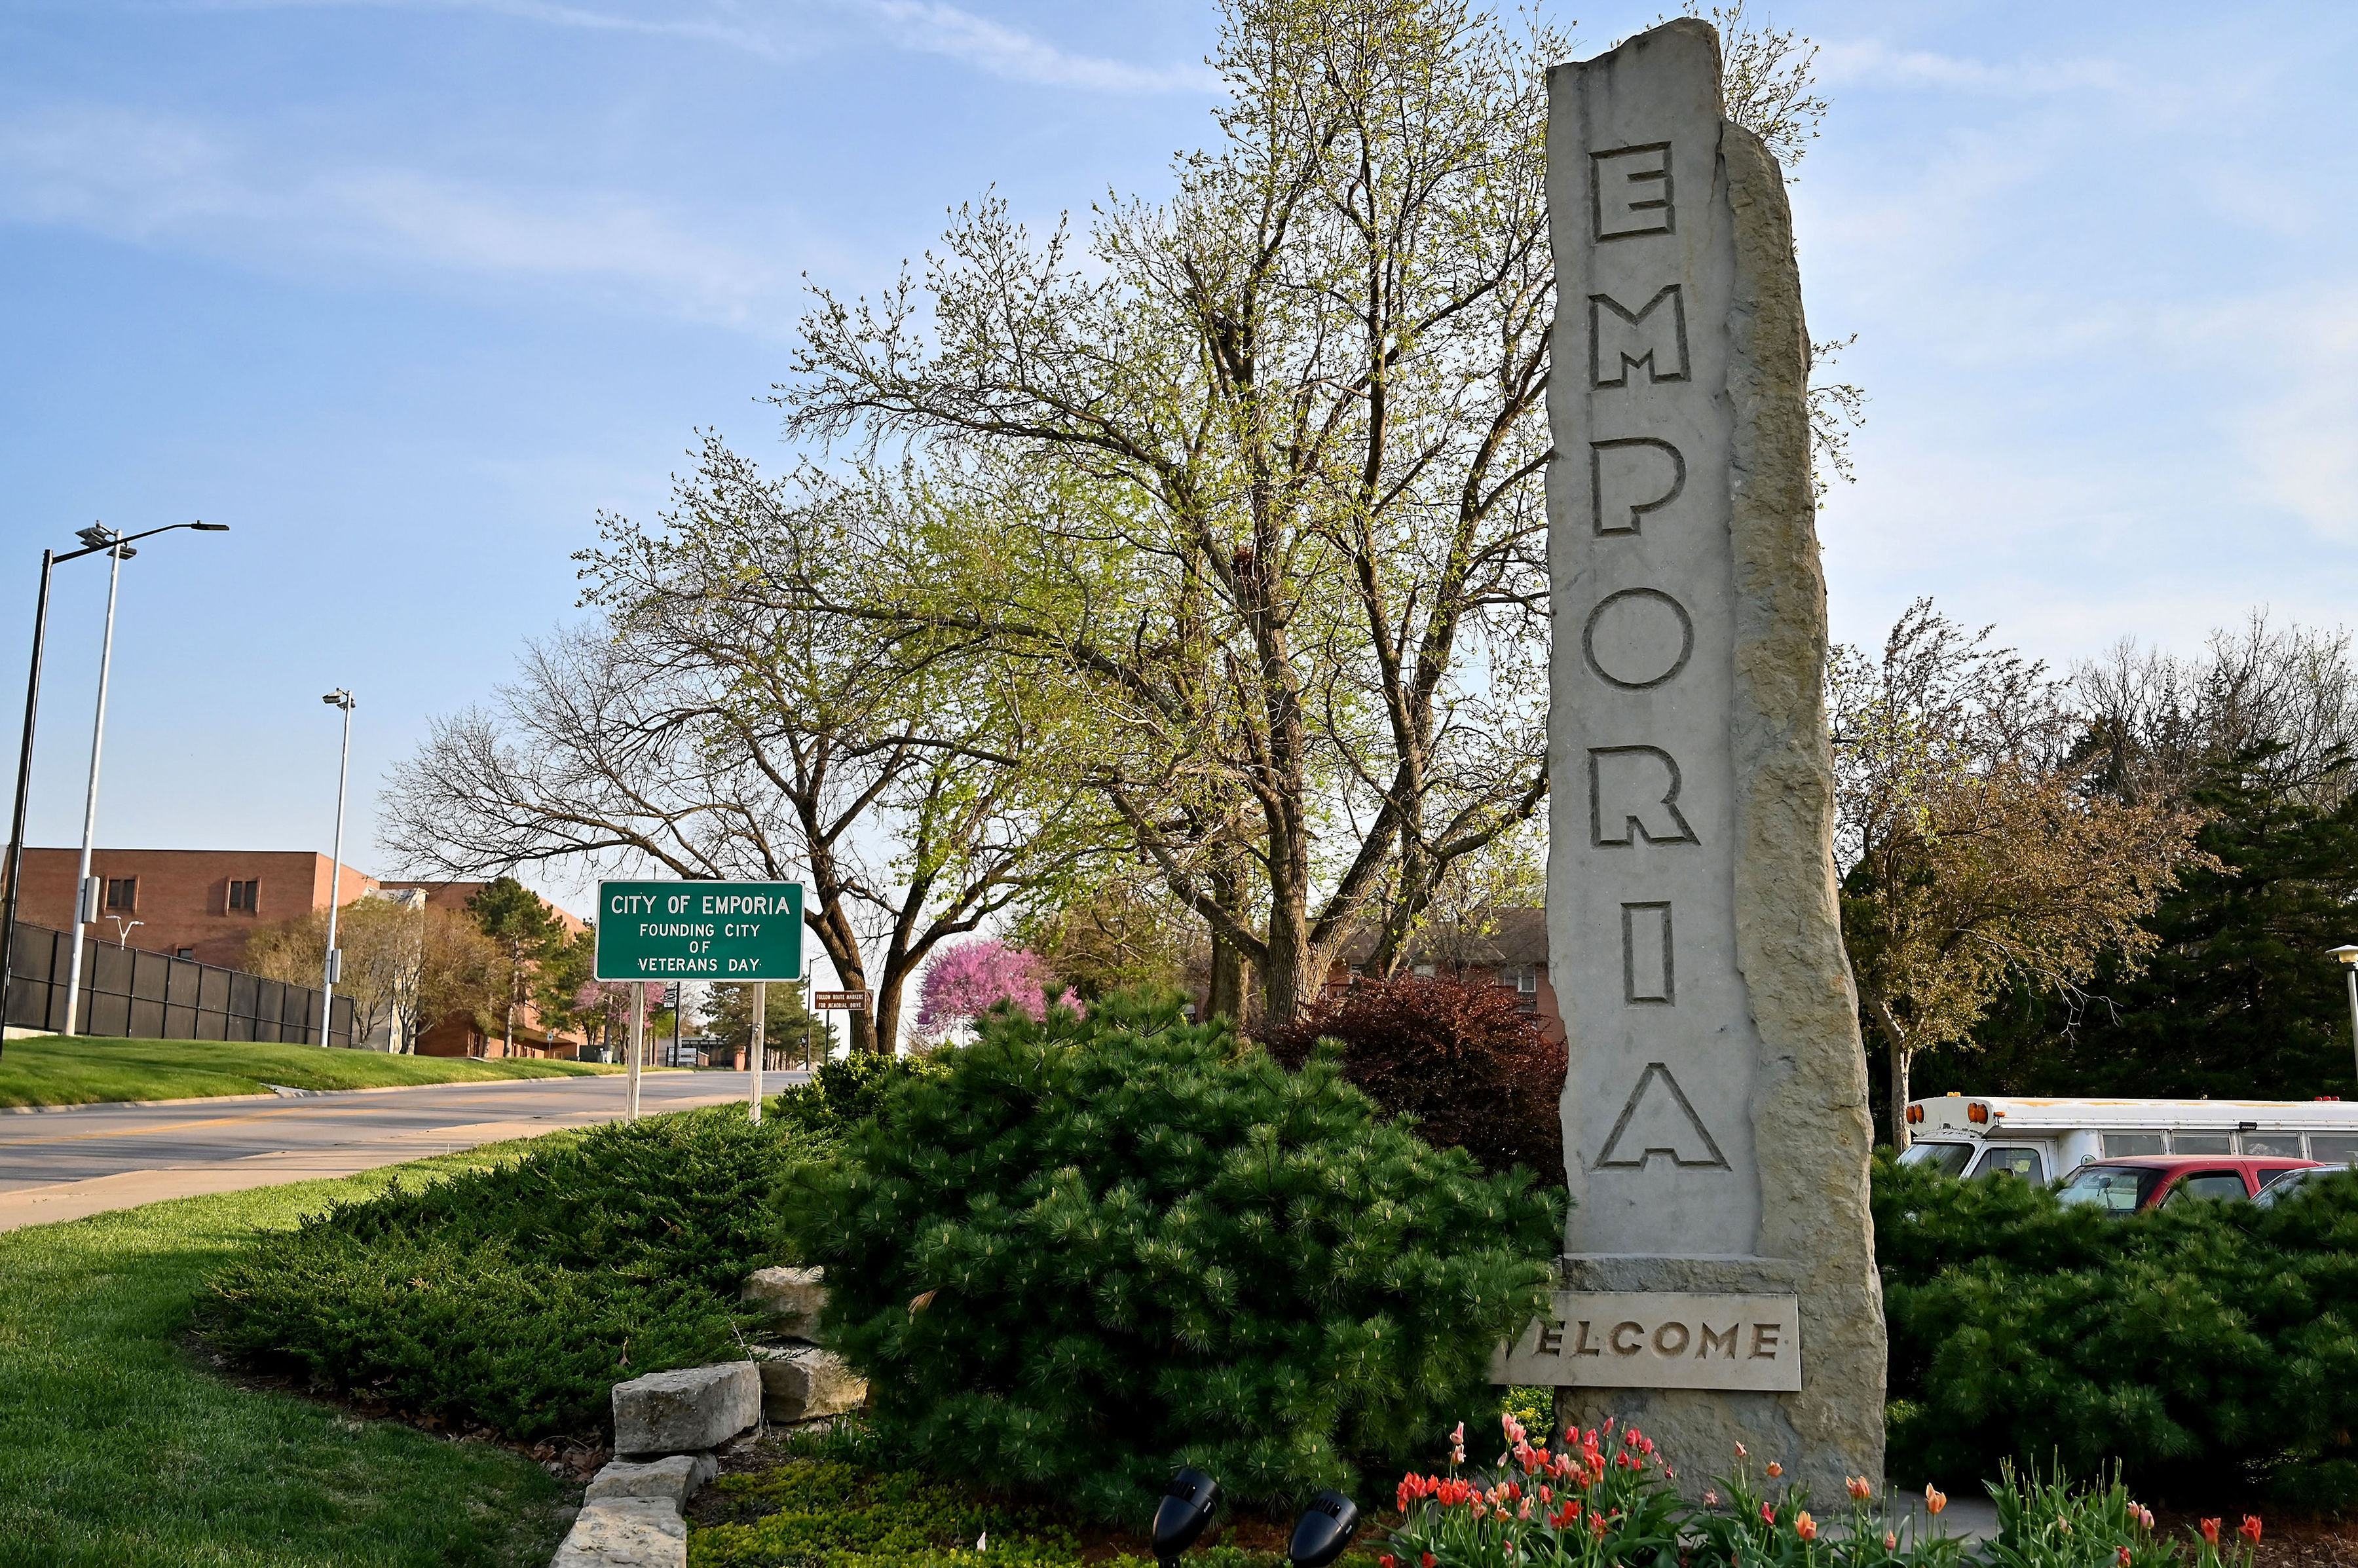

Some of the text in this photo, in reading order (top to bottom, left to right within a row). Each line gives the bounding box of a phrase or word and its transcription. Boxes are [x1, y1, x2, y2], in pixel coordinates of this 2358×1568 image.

[1581, 141, 1733, 1173] EMPORIA
[611, 895, 791, 915] CITY OF EMPORIA
[640, 924, 760, 937] FOUNDING CITY
[689, 941, 711, 954] OF
[639, 958, 760, 971] VETERANS DAY
[1499, 1320, 1781, 1360] ELCOME
